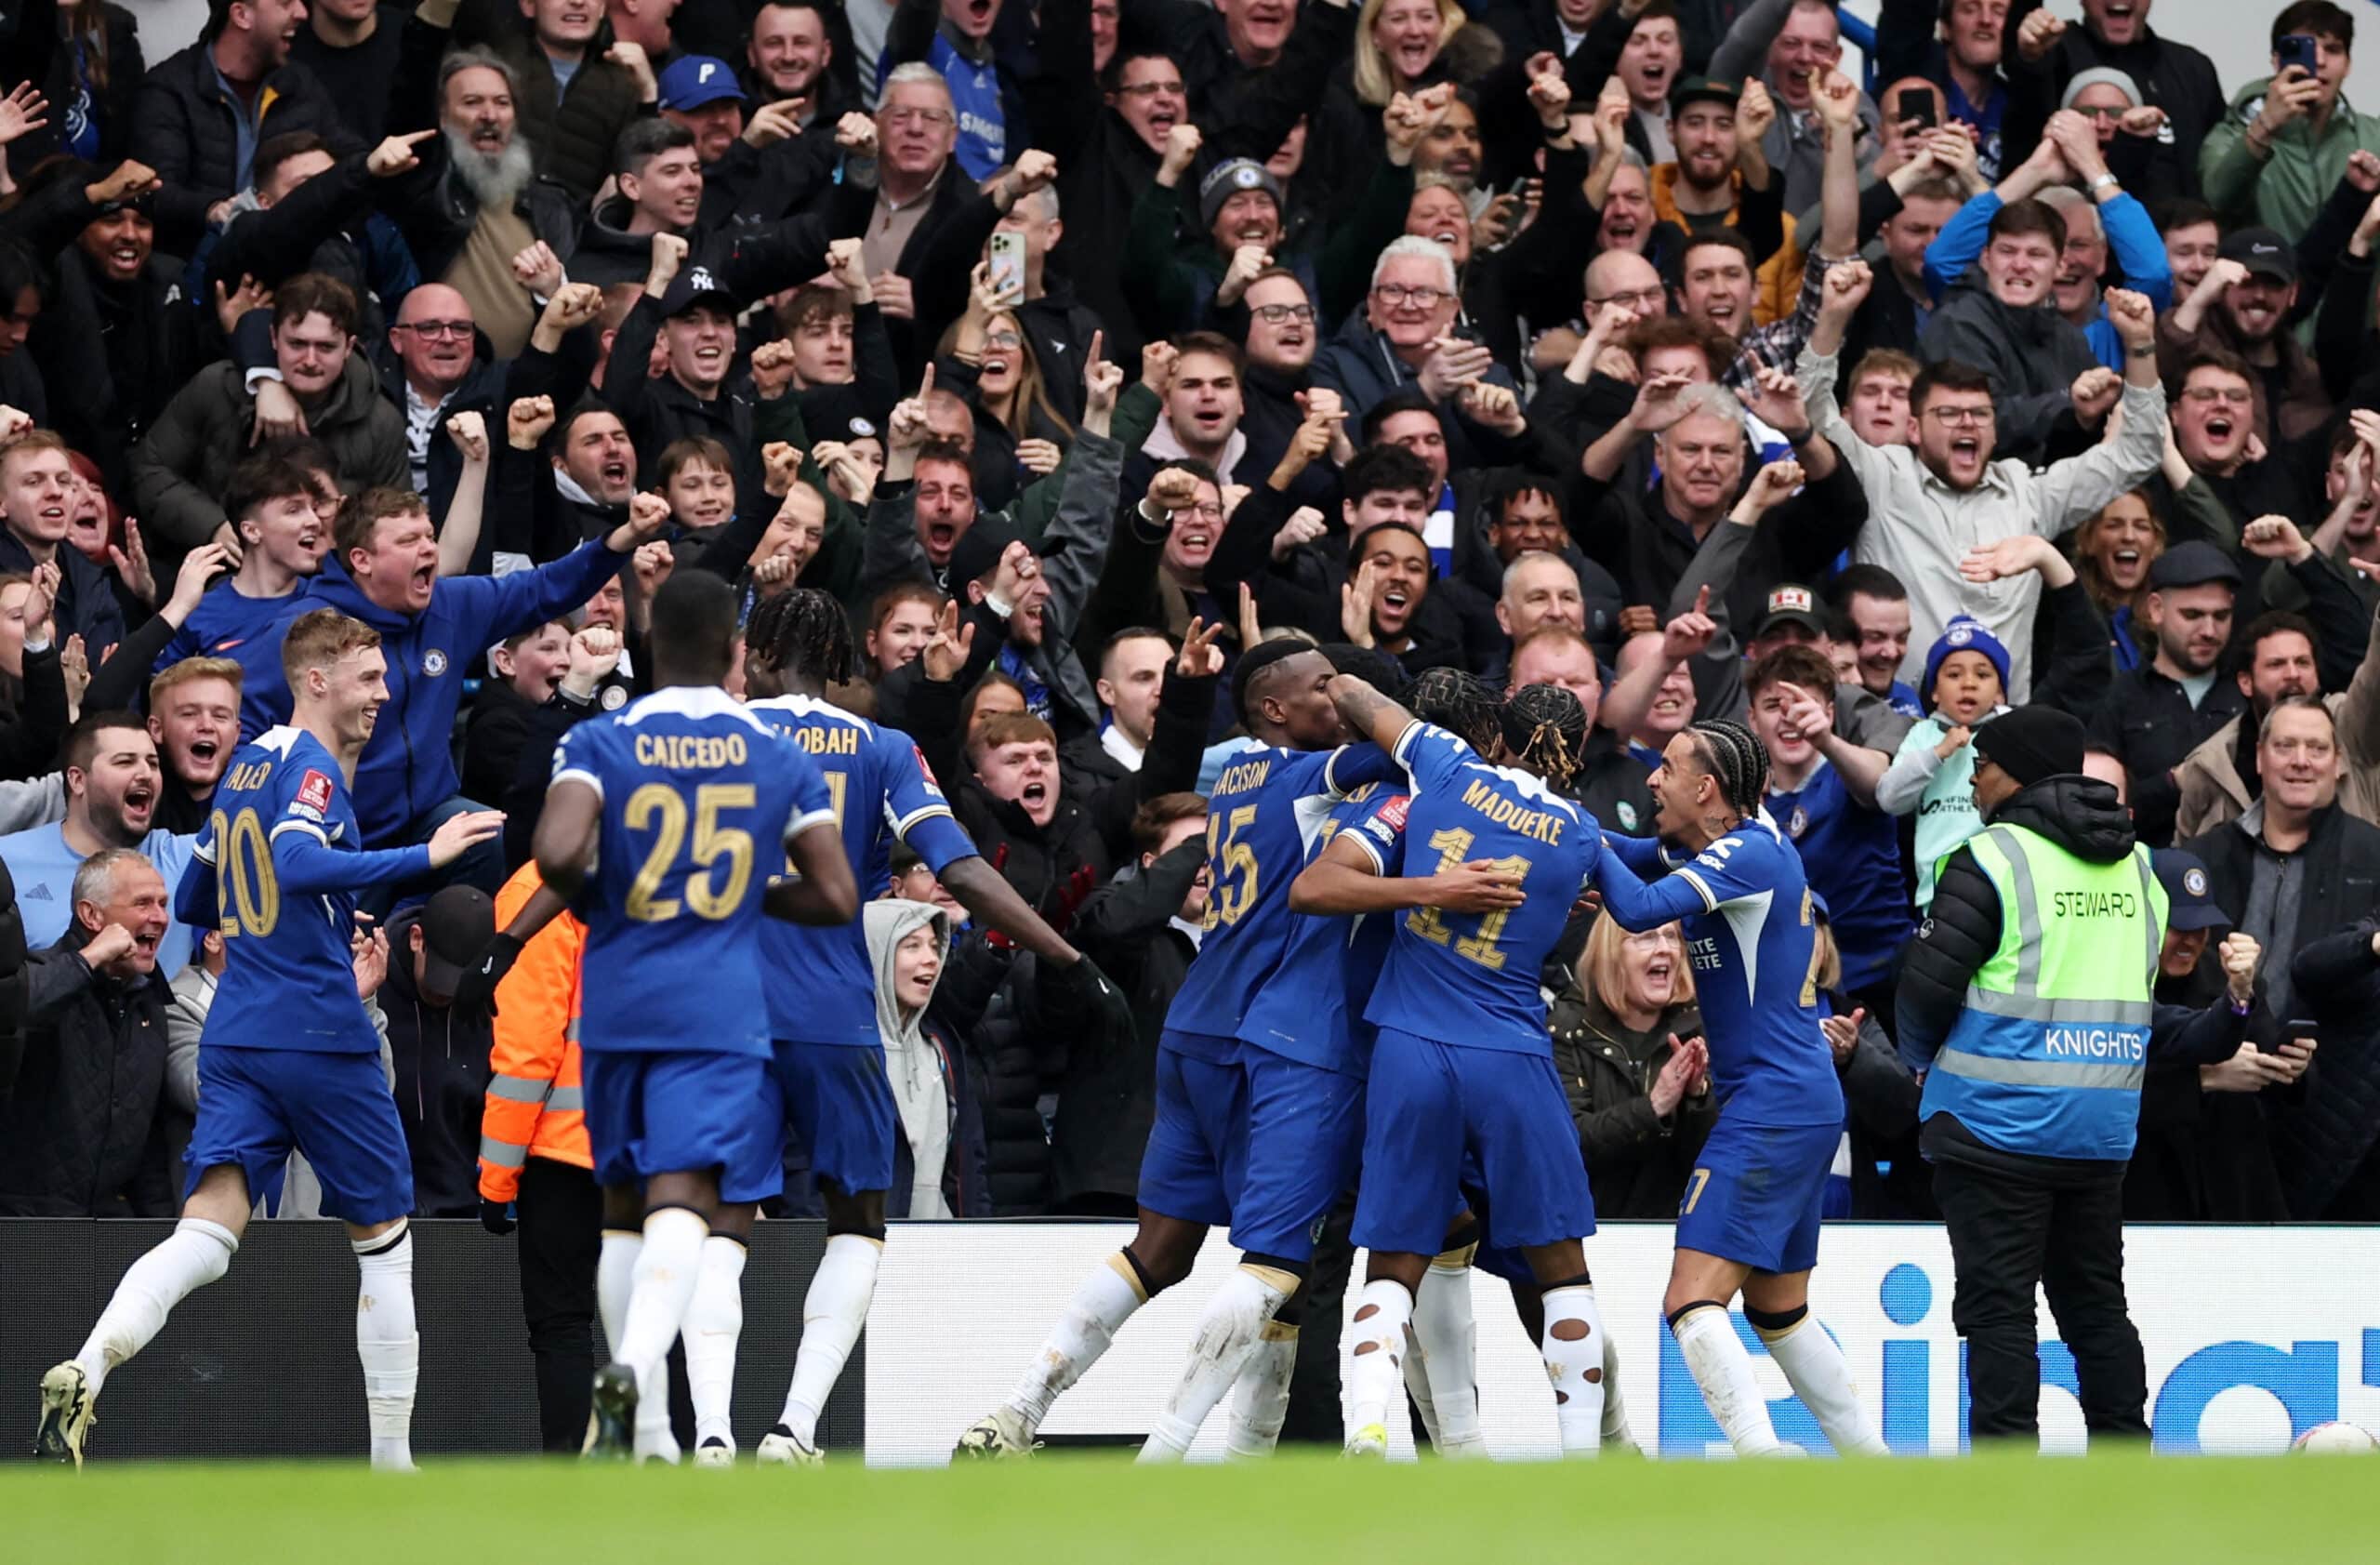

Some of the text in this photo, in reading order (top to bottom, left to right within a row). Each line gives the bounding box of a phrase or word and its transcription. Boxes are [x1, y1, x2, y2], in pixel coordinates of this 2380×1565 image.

[699, 63, 715, 84] P
[635, 733, 747, 768] CAICEDO
[1461, 779, 1565, 846] MADUEKE
[624, 782, 756, 922] 25
[1405, 827, 1532, 969] 11
[2054, 891, 2135, 918] STEWARD
[2046, 1028, 2143, 1061] KNIGHTS
[1679, 1168, 1711, 1215] 7
